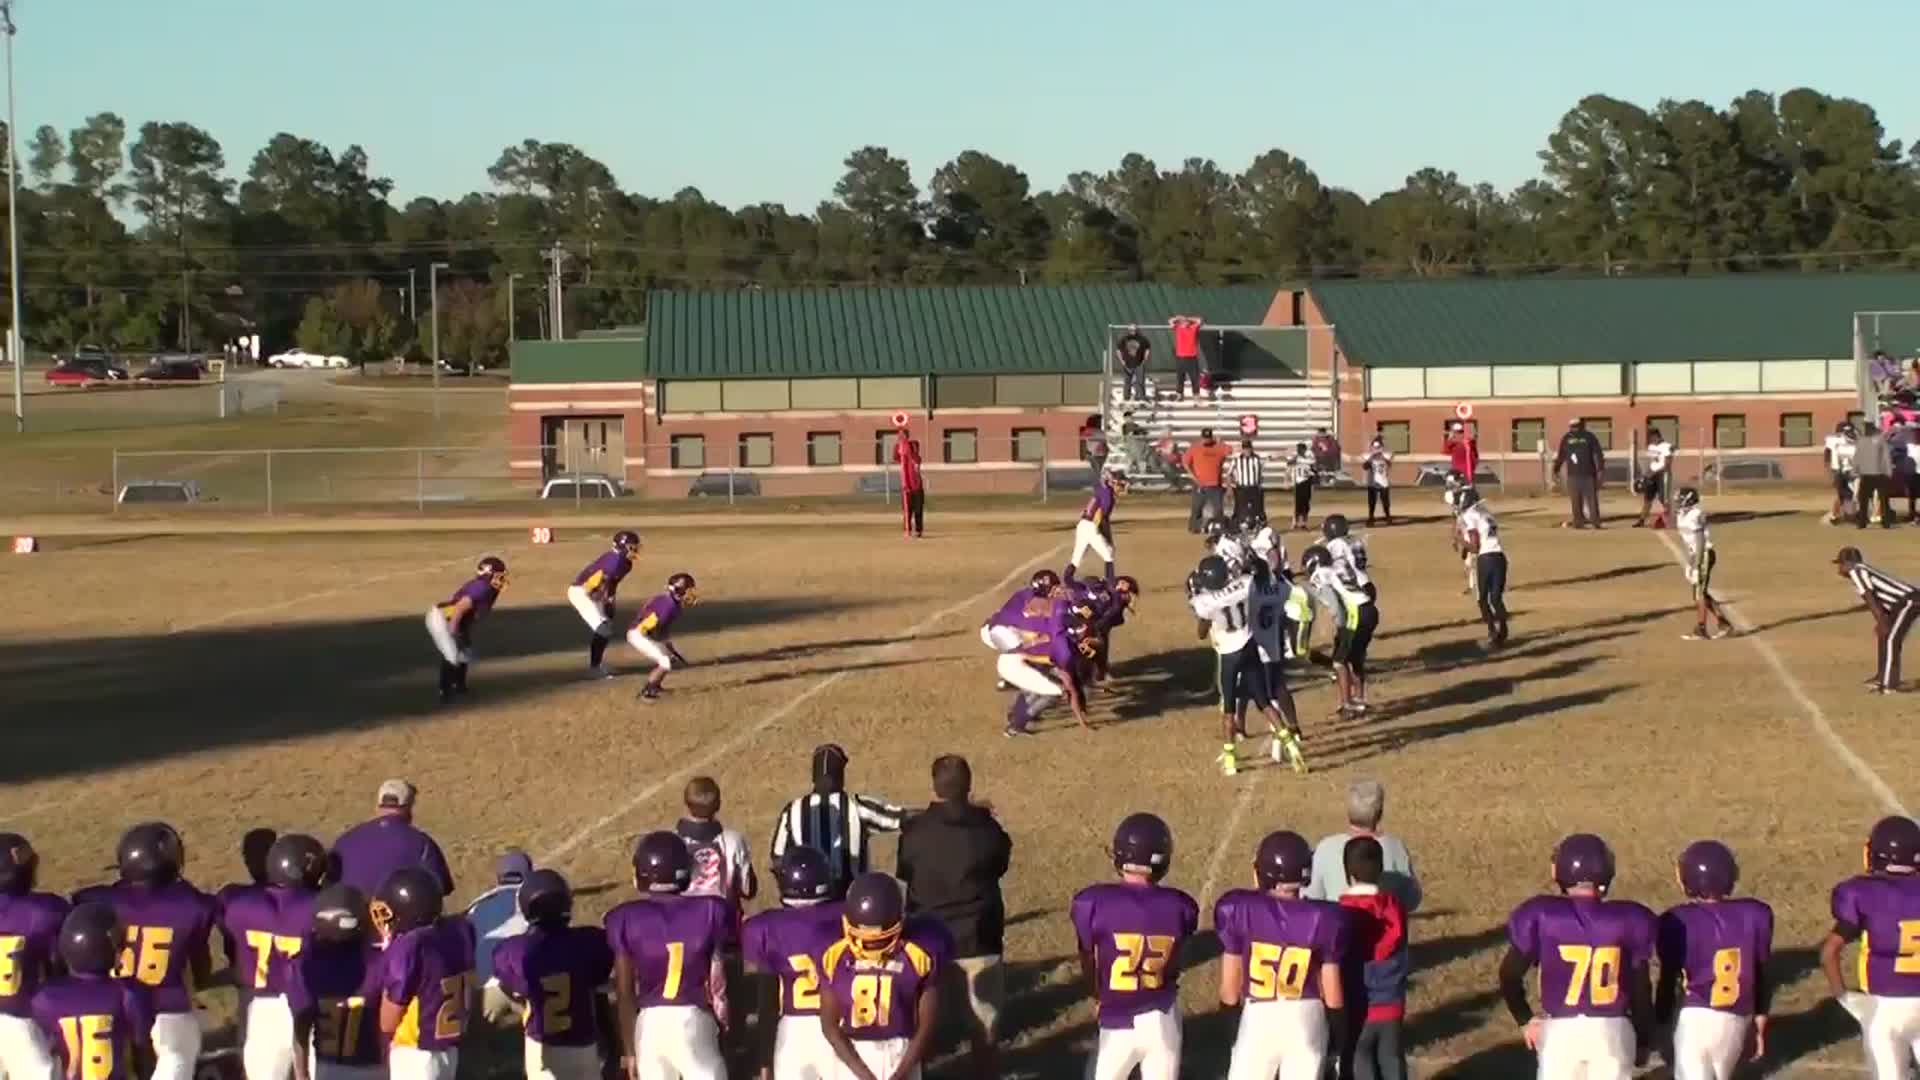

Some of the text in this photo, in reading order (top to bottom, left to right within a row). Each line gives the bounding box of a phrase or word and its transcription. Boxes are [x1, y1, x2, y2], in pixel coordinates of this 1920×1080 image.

[663, 942, 684, 1000] 1
[1110, 932, 1175, 990] 23
[1250, 941, 1311, 1000] 50
[1558, 945, 1621, 1006] 70
[1710, 948, 1741, 1007] 8
[540, 973, 573, 1033] 2
[851, 975, 892, 1028] 81
[58, 1014, 114, 1080] 16
